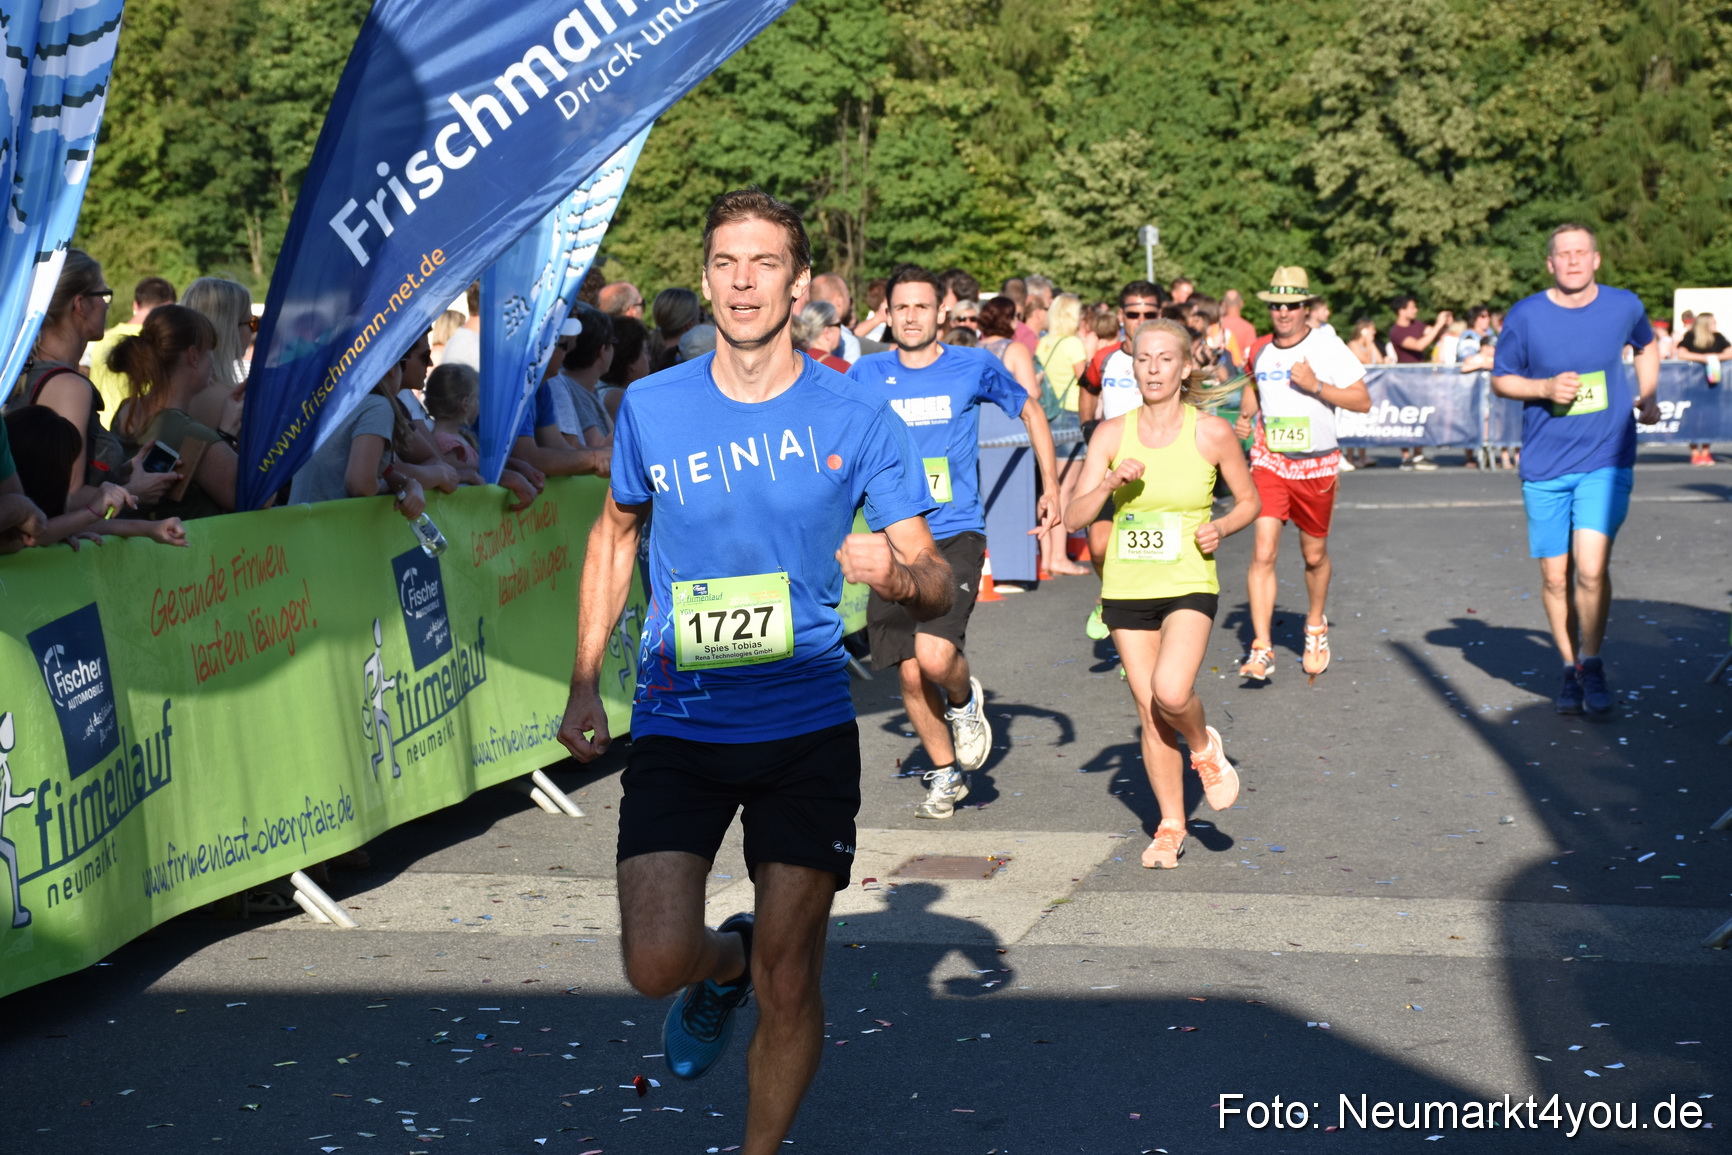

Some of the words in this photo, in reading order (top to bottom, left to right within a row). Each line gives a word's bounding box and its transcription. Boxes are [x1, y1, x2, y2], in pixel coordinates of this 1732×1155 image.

[554, 42, 641, 120] Druck
[258, 248, 446, 472] www.frischmann-net.de
[1271, 429, 1305, 441] 1745
[1127, 530, 1164, 549] 333
[151, 554, 228, 637] Gesunde
[231, 544, 289, 597] Firmen
[408, 580, 438, 610] Fischer
[191, 618, 250, 686] laufen
[247, 578, 317, 657] länger!
[688, 606, 774, 644] 1727
[704, 644, 730, 655] Spies
[731, 641, 763, 651] Tobias
[53, 657, 102, 699] Fischer
[395, 616, 487, 737] firmenlauf
[711, 650, 753, 660] Technologies
[753, 647, 773, 656] GmbH
[67, 681, 104, 711] AUTOMOBILE
[406, 716, 455, 766] neumarkt
[35, 698, 172, 871] firmenlauf
[142, 784, 355, 899] www.firmenlauf-oberpfalz.de
[47, 836, 118, 909] neumarkt
